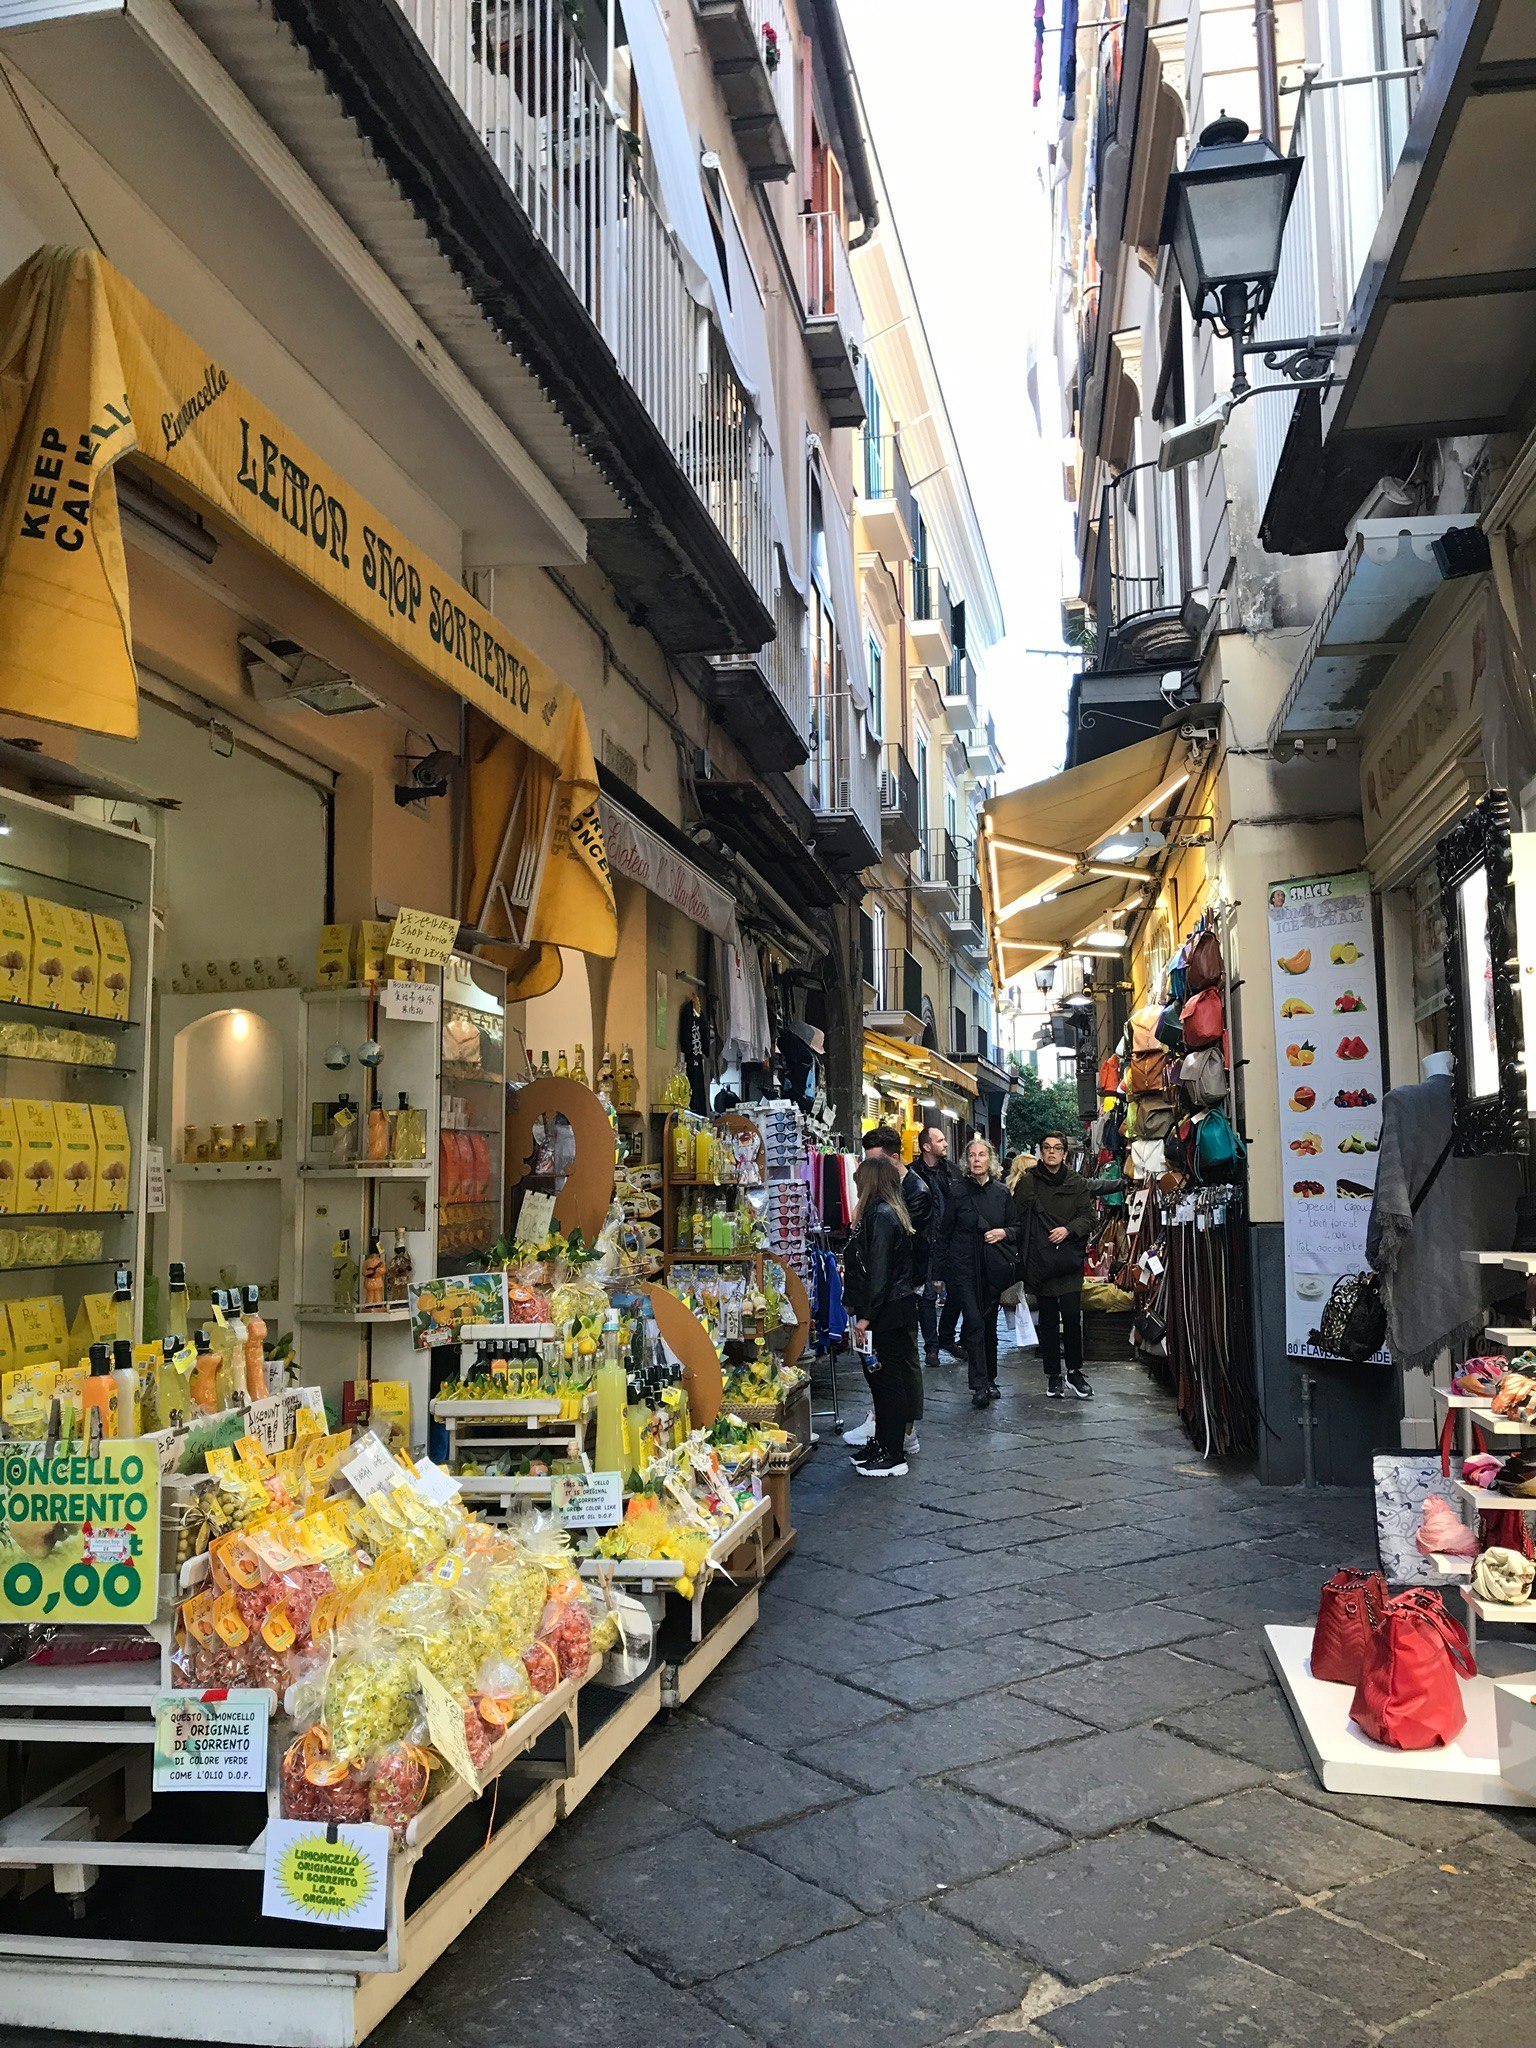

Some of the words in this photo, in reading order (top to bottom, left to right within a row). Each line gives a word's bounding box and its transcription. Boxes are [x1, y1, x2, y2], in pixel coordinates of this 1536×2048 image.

[20, 427, 68, 540] KEEP
[237, 417, 348, 569] LEMON
[362, 525, 422, 624] SHOP
[429, 584, 530, 715] SORRENTO
[1290, 882, 1332, 901] SNACK
[1297, 1199, 1336, 1218] Special
[1287, 1343, 1298, 1354] 80
[0, 1455, 143, 1485] ONCELLO
[170, 1712, 202, 1722] QUESTO
[206, 1712, 255, 1722] LIMONCELLO
[190, 1724, 250, 1736] ORIGINALE
[174, 1740, 187, 1751] DI
[194, 1739, 250, 1751] SORRENTO
[175, 1757, 184, 1766] DI
[189, 1756, 219, 1765] COLORE
[224, 1756, 248, 1765] VERDE
[169, 1771, 192, 1780] COME
[197, 1770, 223, 1780] L'OLIO
[228, 1771, 251, 1780] D.O.P.
[294, 1849, 360, 1866] LIMONCELLO
[293, 1871, 304, 1880] DI
[306, 1872, 358, 1887] SORRENTO
[302, 1893, 346, 1907] ORGANIC
